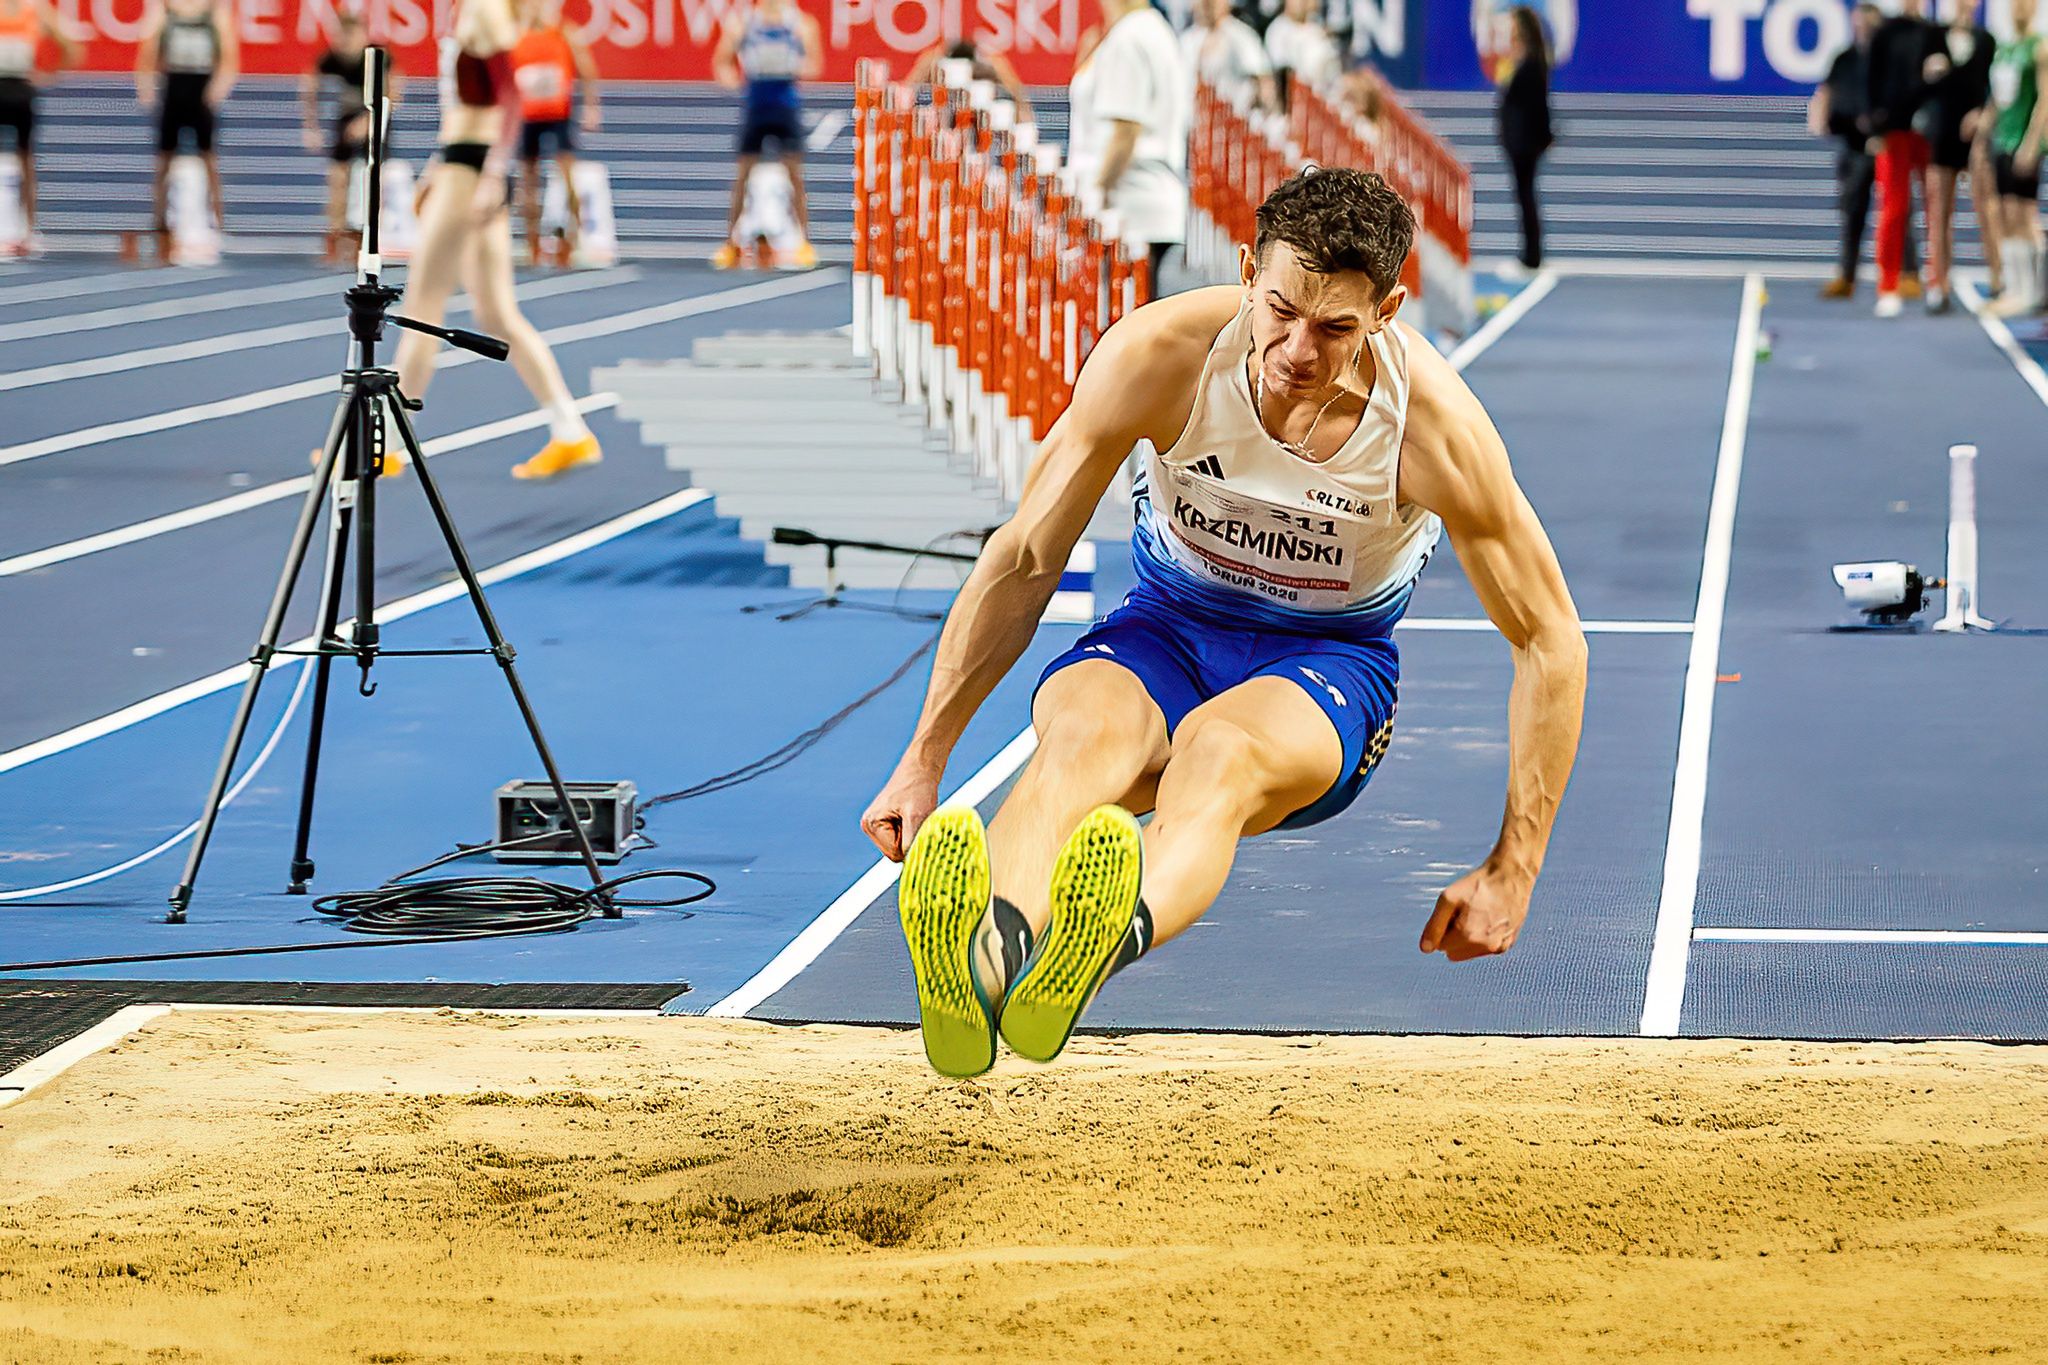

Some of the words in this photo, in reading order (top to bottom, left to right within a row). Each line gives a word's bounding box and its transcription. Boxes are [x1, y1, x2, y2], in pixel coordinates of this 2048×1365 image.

[1316, 491, 1352, 513] RLTL
[1173, 496, 1343, 566] KRZEMIŃSKI
[1270, 509, 1338, 537] 211
